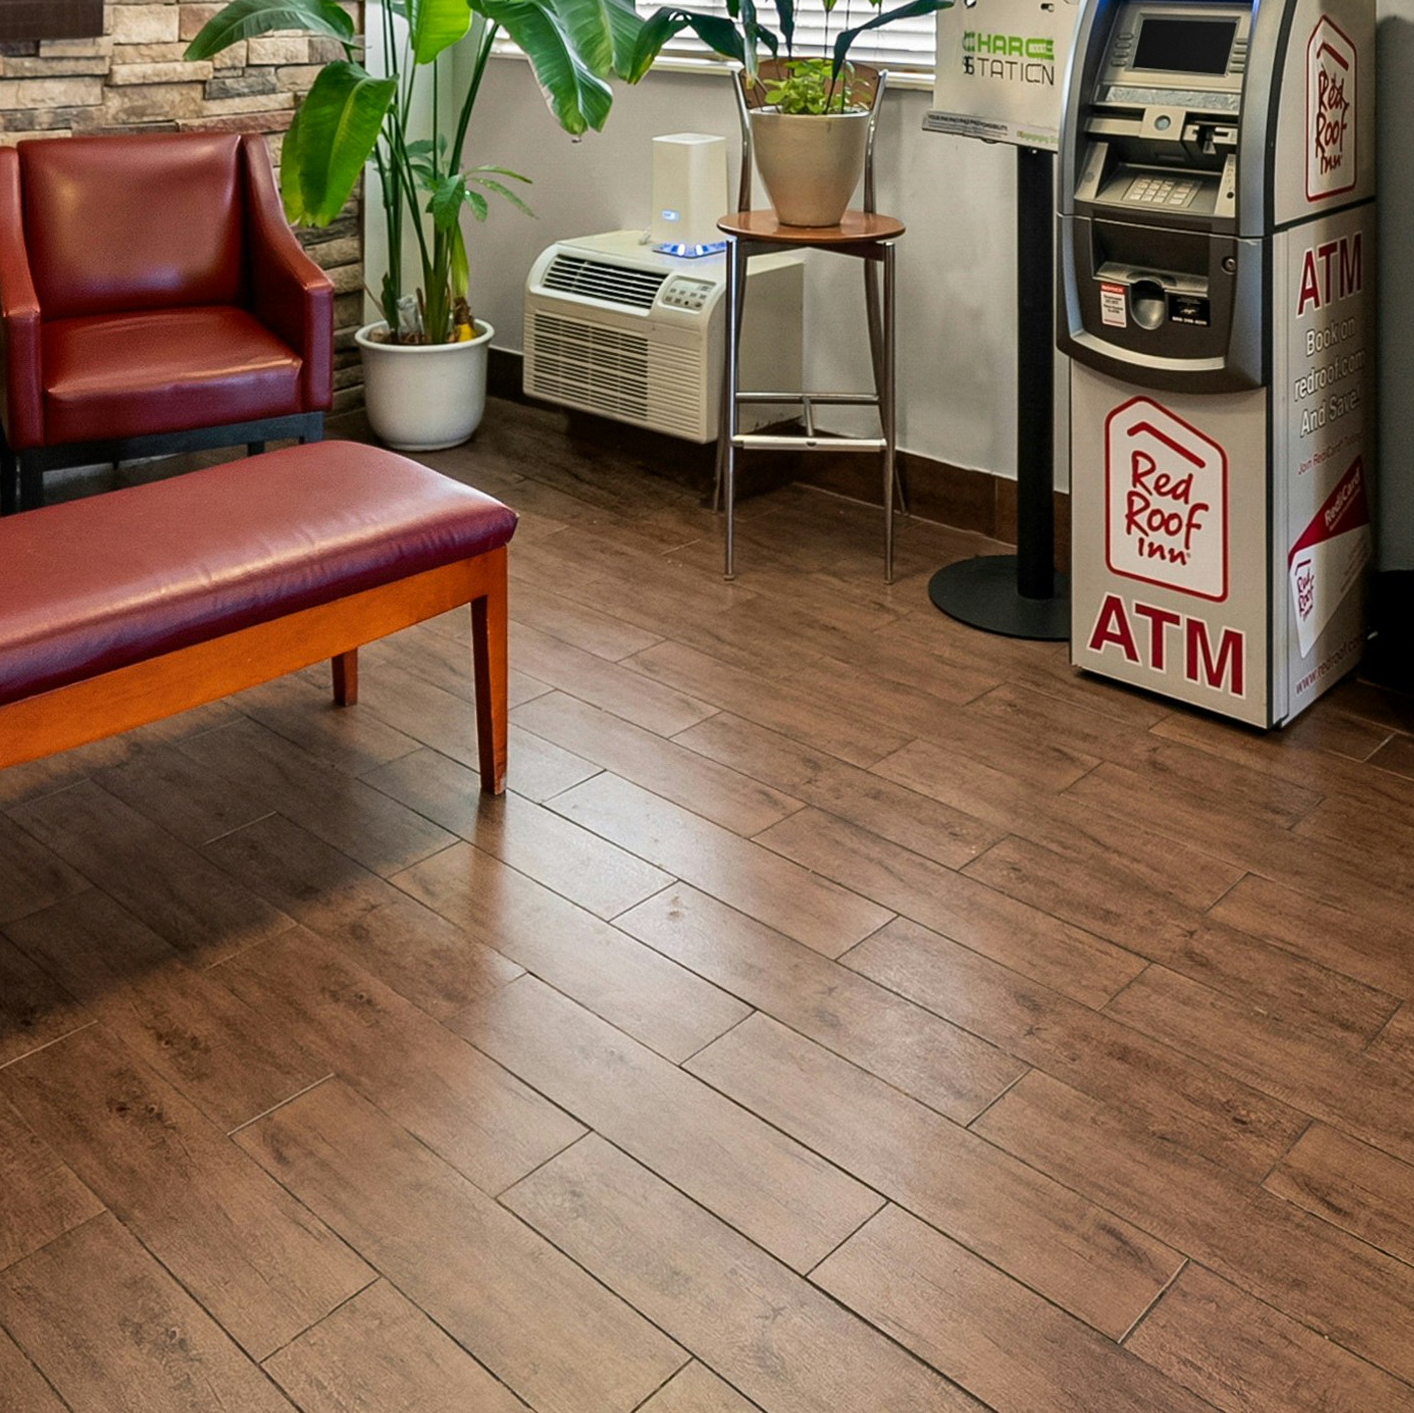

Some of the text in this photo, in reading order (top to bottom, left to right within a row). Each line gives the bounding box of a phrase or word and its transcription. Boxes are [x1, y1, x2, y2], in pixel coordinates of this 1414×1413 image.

[962, 56, 1055, 85] STATION
[1318, 70, 1345, 112] Red
[1315, 101, 1350, 158] Roof
[1296, 232, 1363, 318] ATM
[1306, 318, 1356, 357] Book on
[1294, 348, 1365, 401] redroof.com
[1299, 399, 1326, 438] And
[1131, 450, 1193, 505] Red
[1125, 490, 1209, 550] Roof
[1088, 593, 1245, 698] ATM
